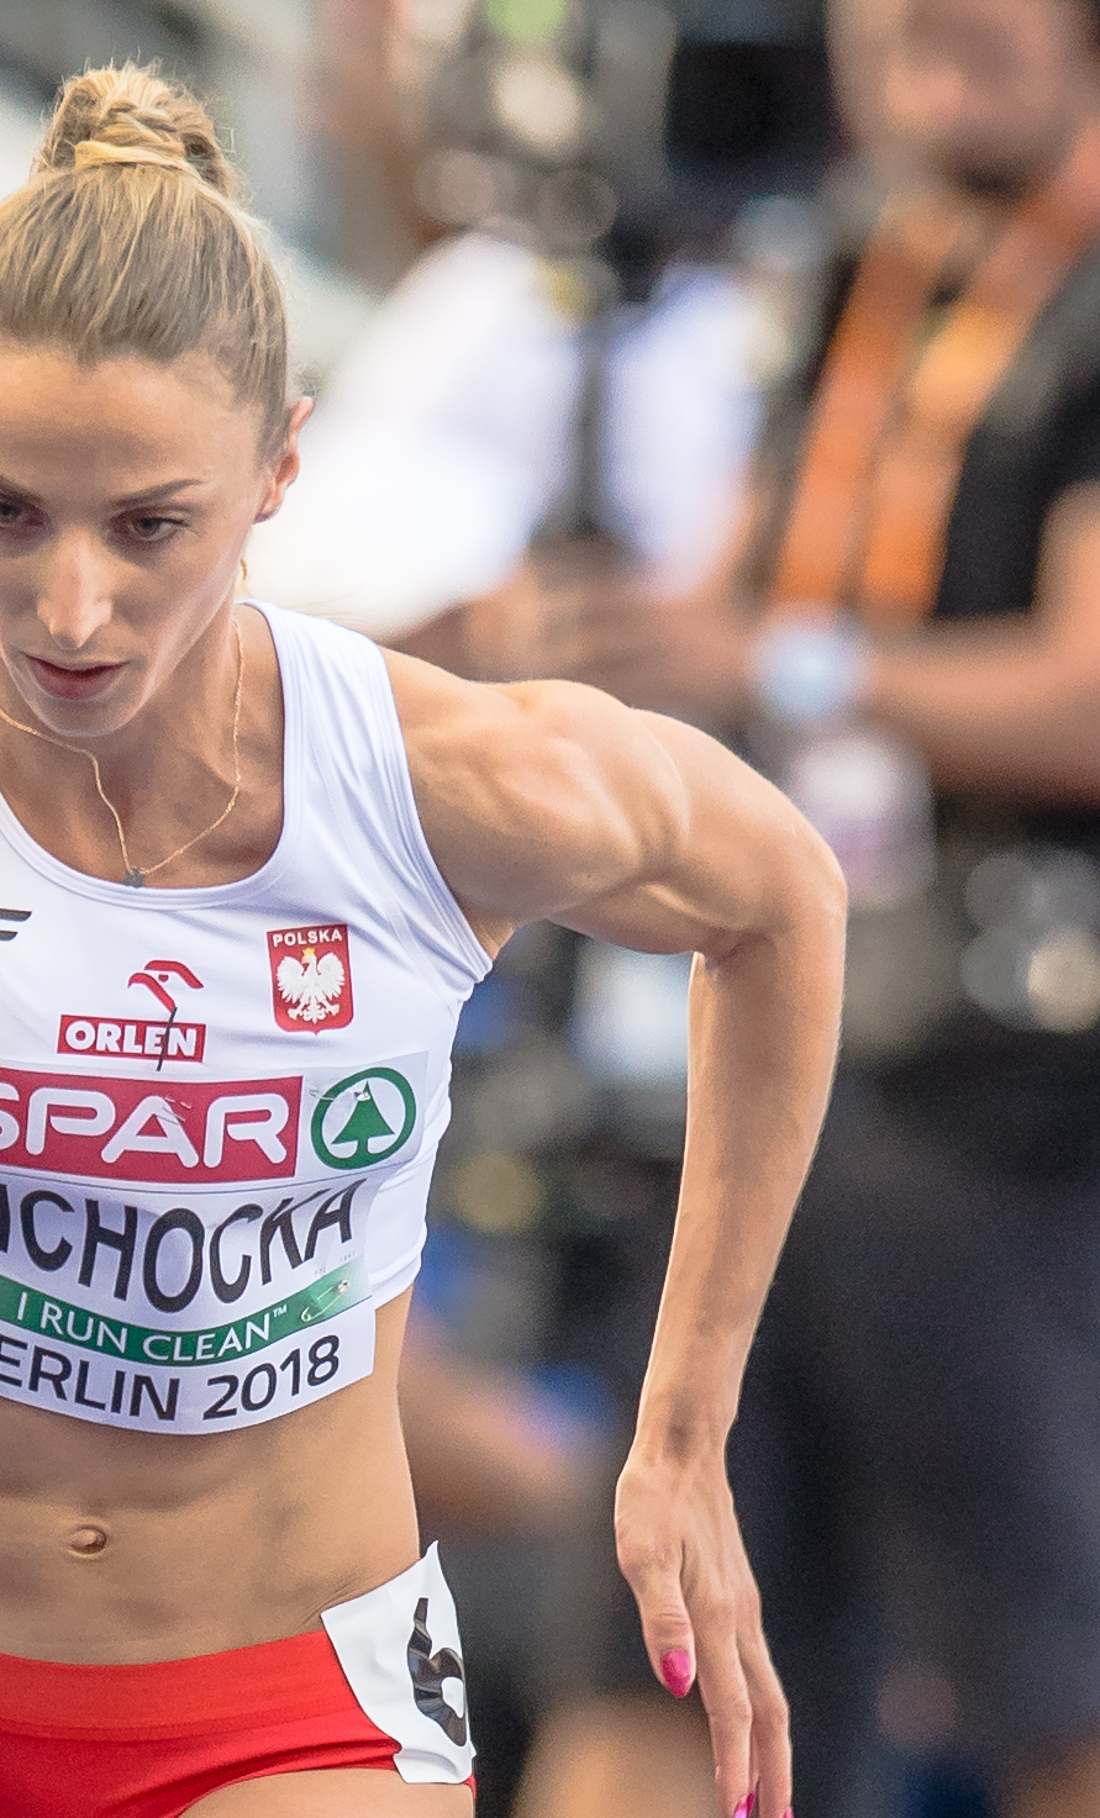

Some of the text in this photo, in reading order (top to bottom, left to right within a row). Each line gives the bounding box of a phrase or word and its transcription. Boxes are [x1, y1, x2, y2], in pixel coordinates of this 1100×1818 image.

[272, 929, 343, 948] POLSKA
[64, 1022, 197, 1057] ORLEN
[16, 1292, 28, 1321] I
[39, 1302, 128, 1354] RUN
[203, 1334, 340, 1419] 2018
